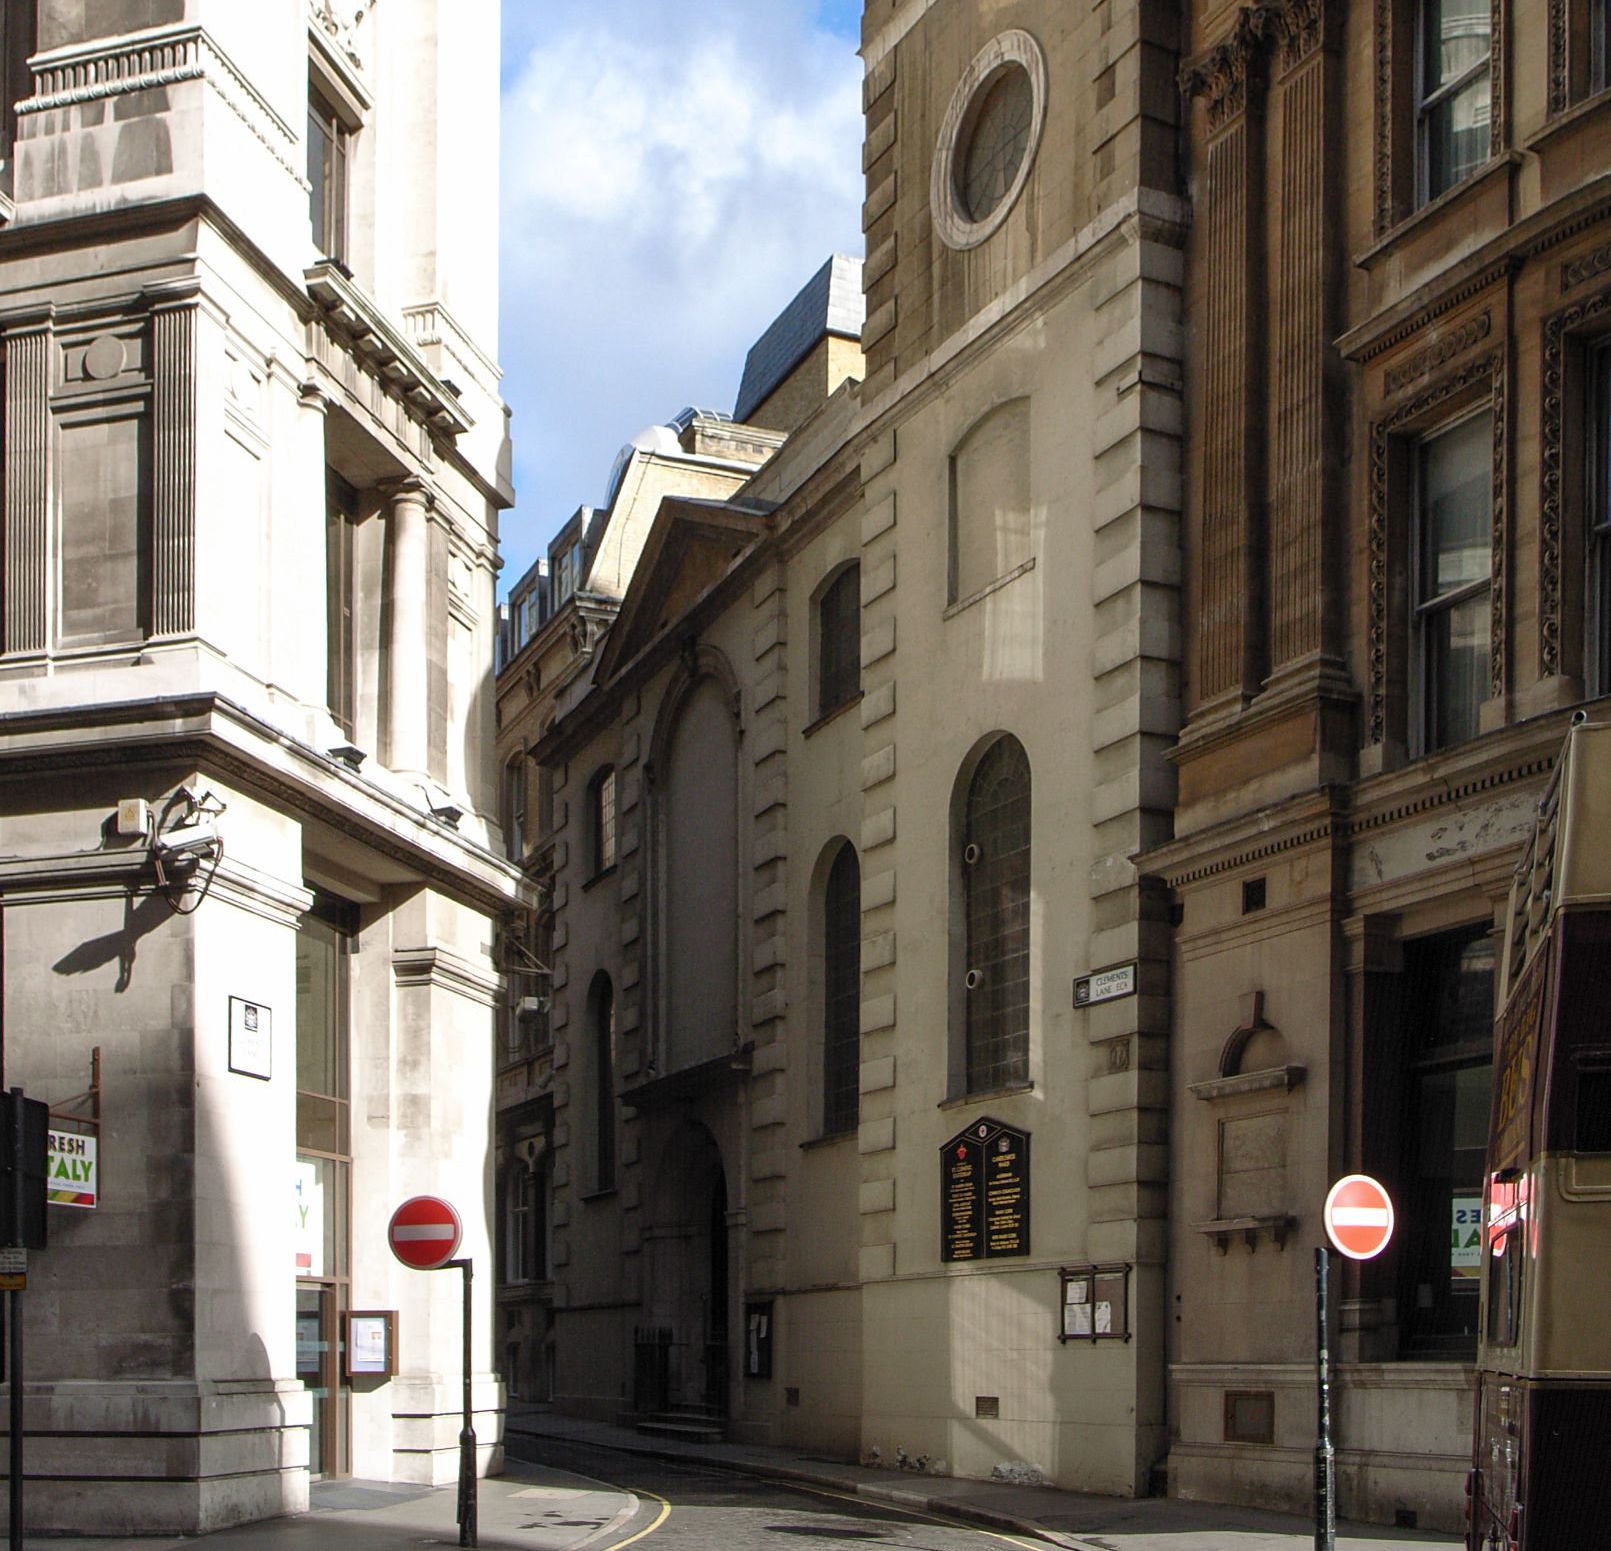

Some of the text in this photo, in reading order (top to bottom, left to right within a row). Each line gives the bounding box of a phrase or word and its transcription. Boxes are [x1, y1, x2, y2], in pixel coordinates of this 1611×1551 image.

[1095, 981, 1128, 997] LANE EC4
[1096, 970, 1128, 987] CLEMENTS
[1497, 1032, 1534, 1133] BUS
[48, 1134, 86, 1157] RESH
[47, 1155, 93, 1183] TALY
